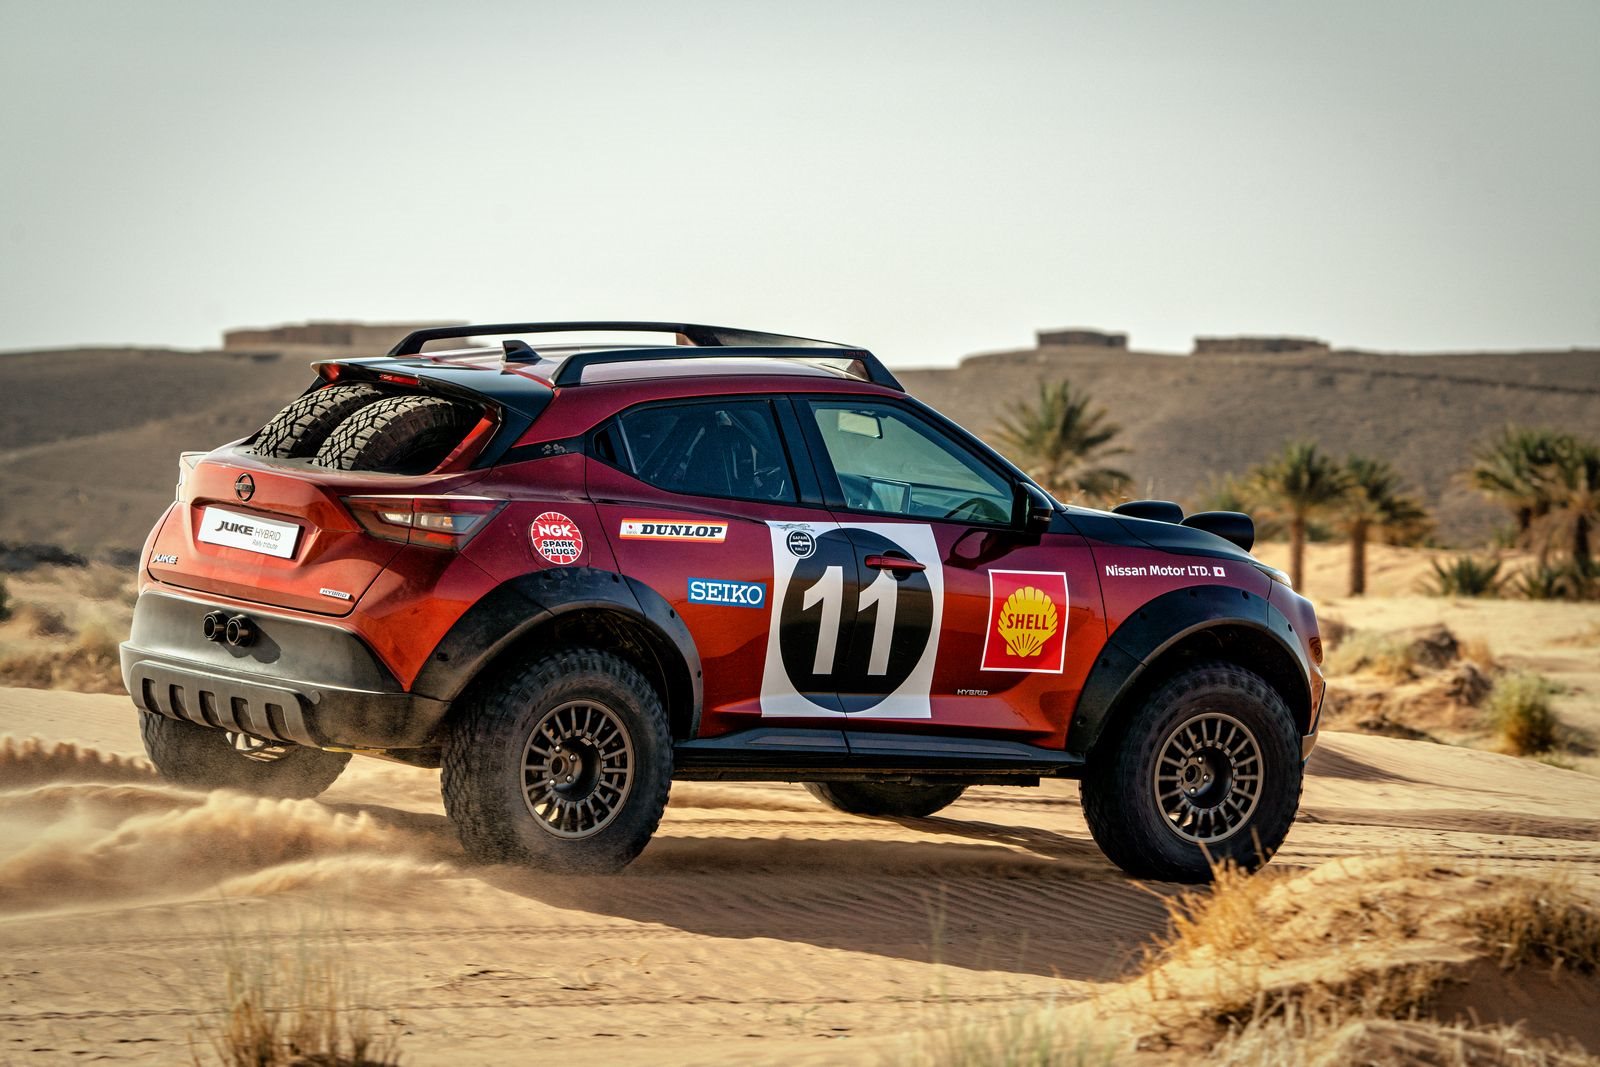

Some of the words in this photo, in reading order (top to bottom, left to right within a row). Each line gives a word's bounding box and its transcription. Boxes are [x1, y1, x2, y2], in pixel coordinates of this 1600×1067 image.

[215, 520, 254, 536] JUKE
[255, 528, 281, 541] HYBRID
[538, 524, 573, 537] NGK
[640, 524, 722, 537] DUNLOP
[542, 540, 574, 548] SPARK
[152, 554, 177, 564] JUKE
[1105, 565, 1147, 576] Nissan
[1149, 565, 1186, 576] Motor
[1187, 565, 1211, 576] LTD.
[322, 589, 347, 597] HYBRID
[690, 581, 763, 604] SEIKO
[803, 566, 898, 676] 11
[1006, 613, 1049, 631] SHELL
